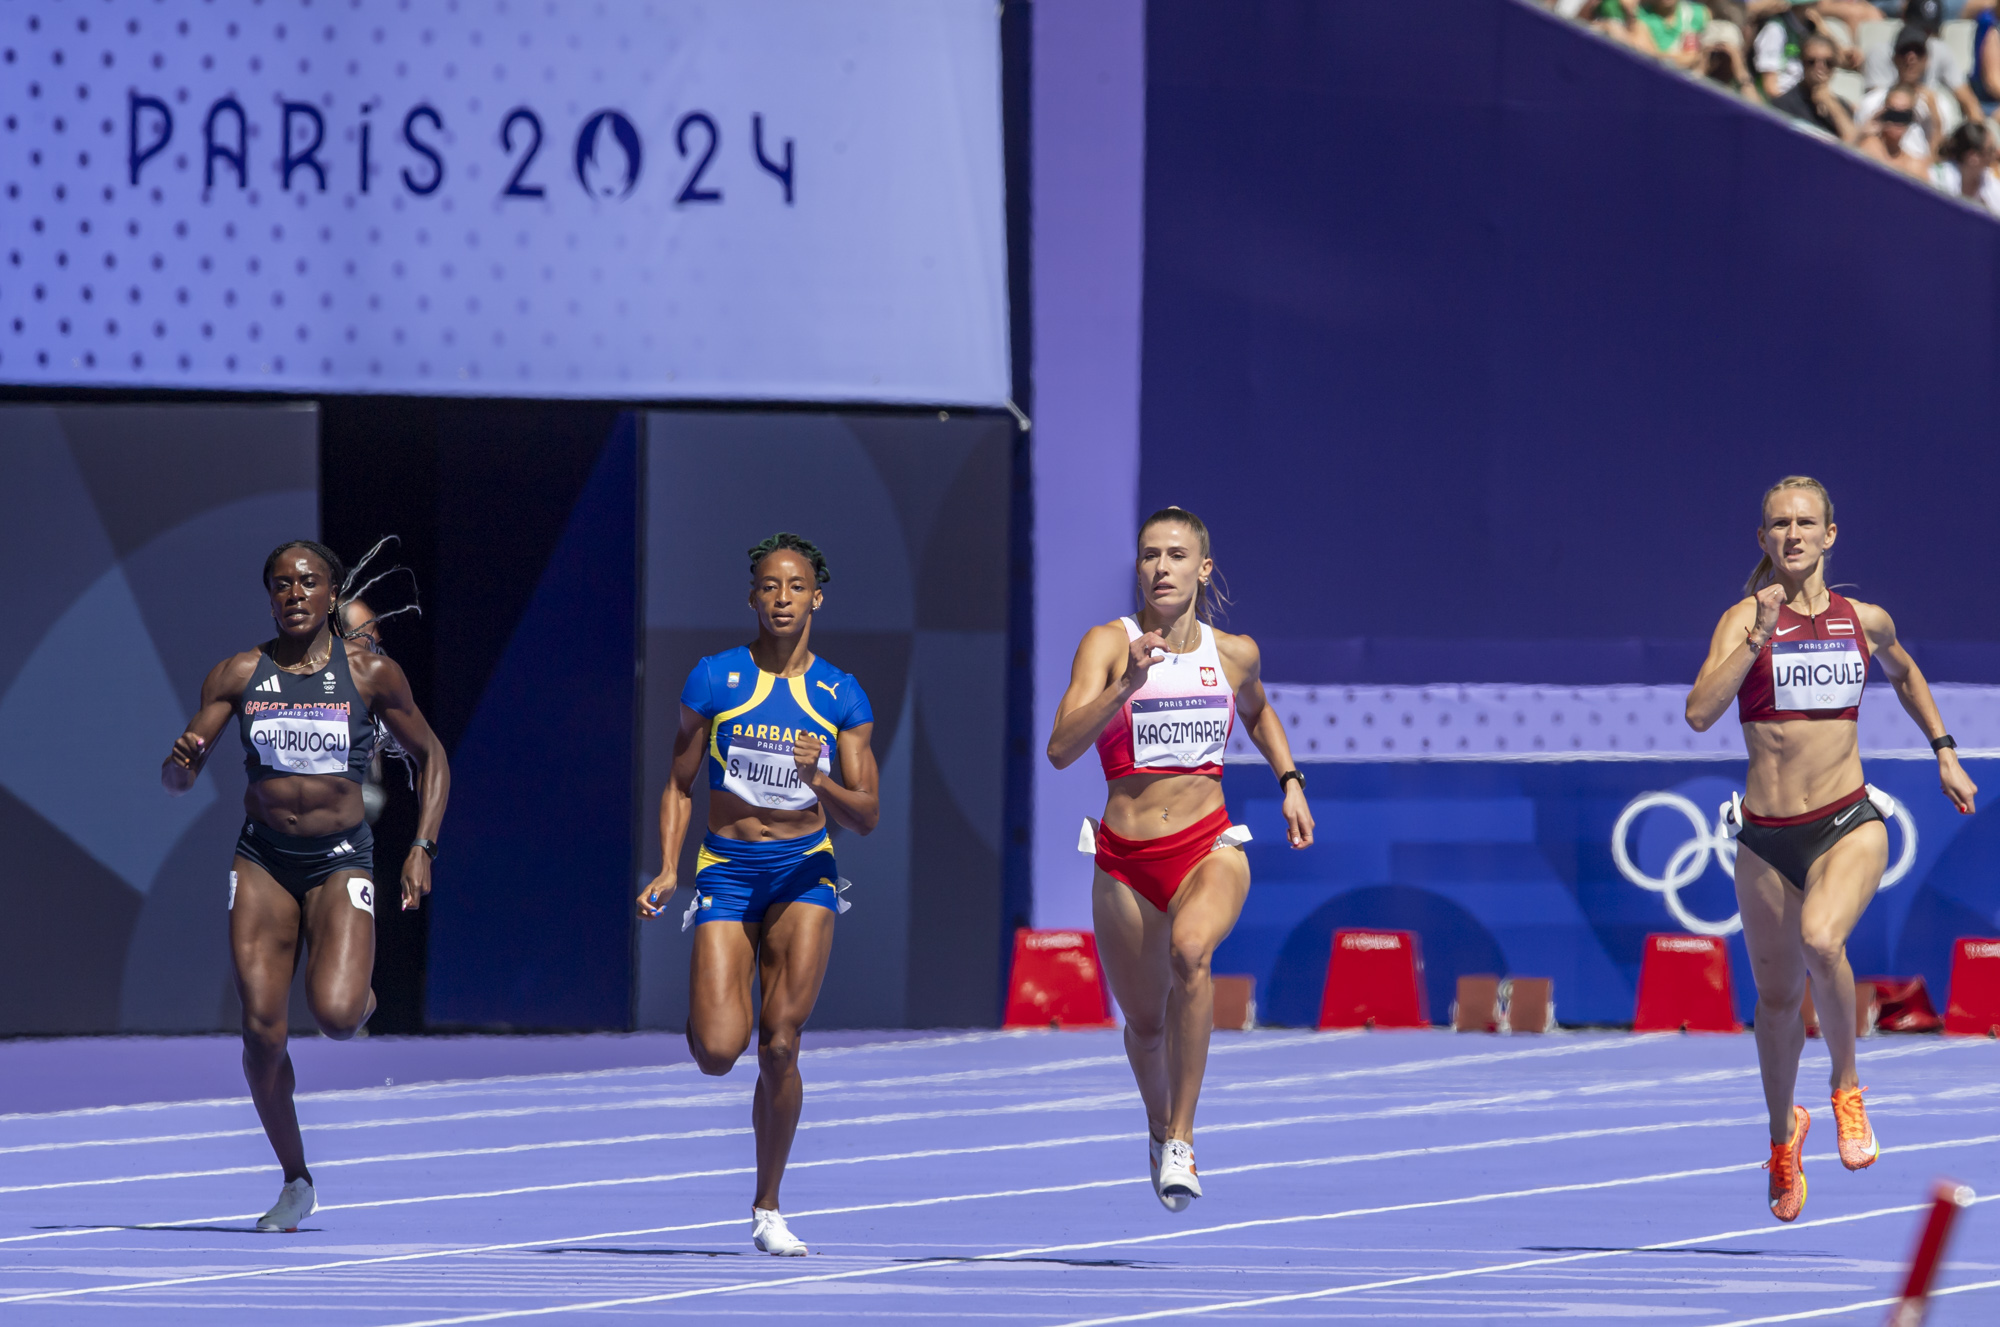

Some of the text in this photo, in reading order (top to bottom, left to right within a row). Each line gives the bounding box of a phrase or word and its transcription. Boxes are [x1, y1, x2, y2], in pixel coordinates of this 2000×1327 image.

[128, 90, 796, 206] PARIS 2024
[1798, 643, 1844, 651] PARIS 2024
[1777, 663, 1863, 687] VAICULE
[1159, 699, 1207, 708] PARIS 2024
[254, 730, 347, 752] OHURUOGU
[1137, 720, 1227, 745] KACZMAREK
[757, 741, 783, 751] PARIS
[729, 758, 802, 789] S. WILLIA
[360, 886, 372, 906] 6
